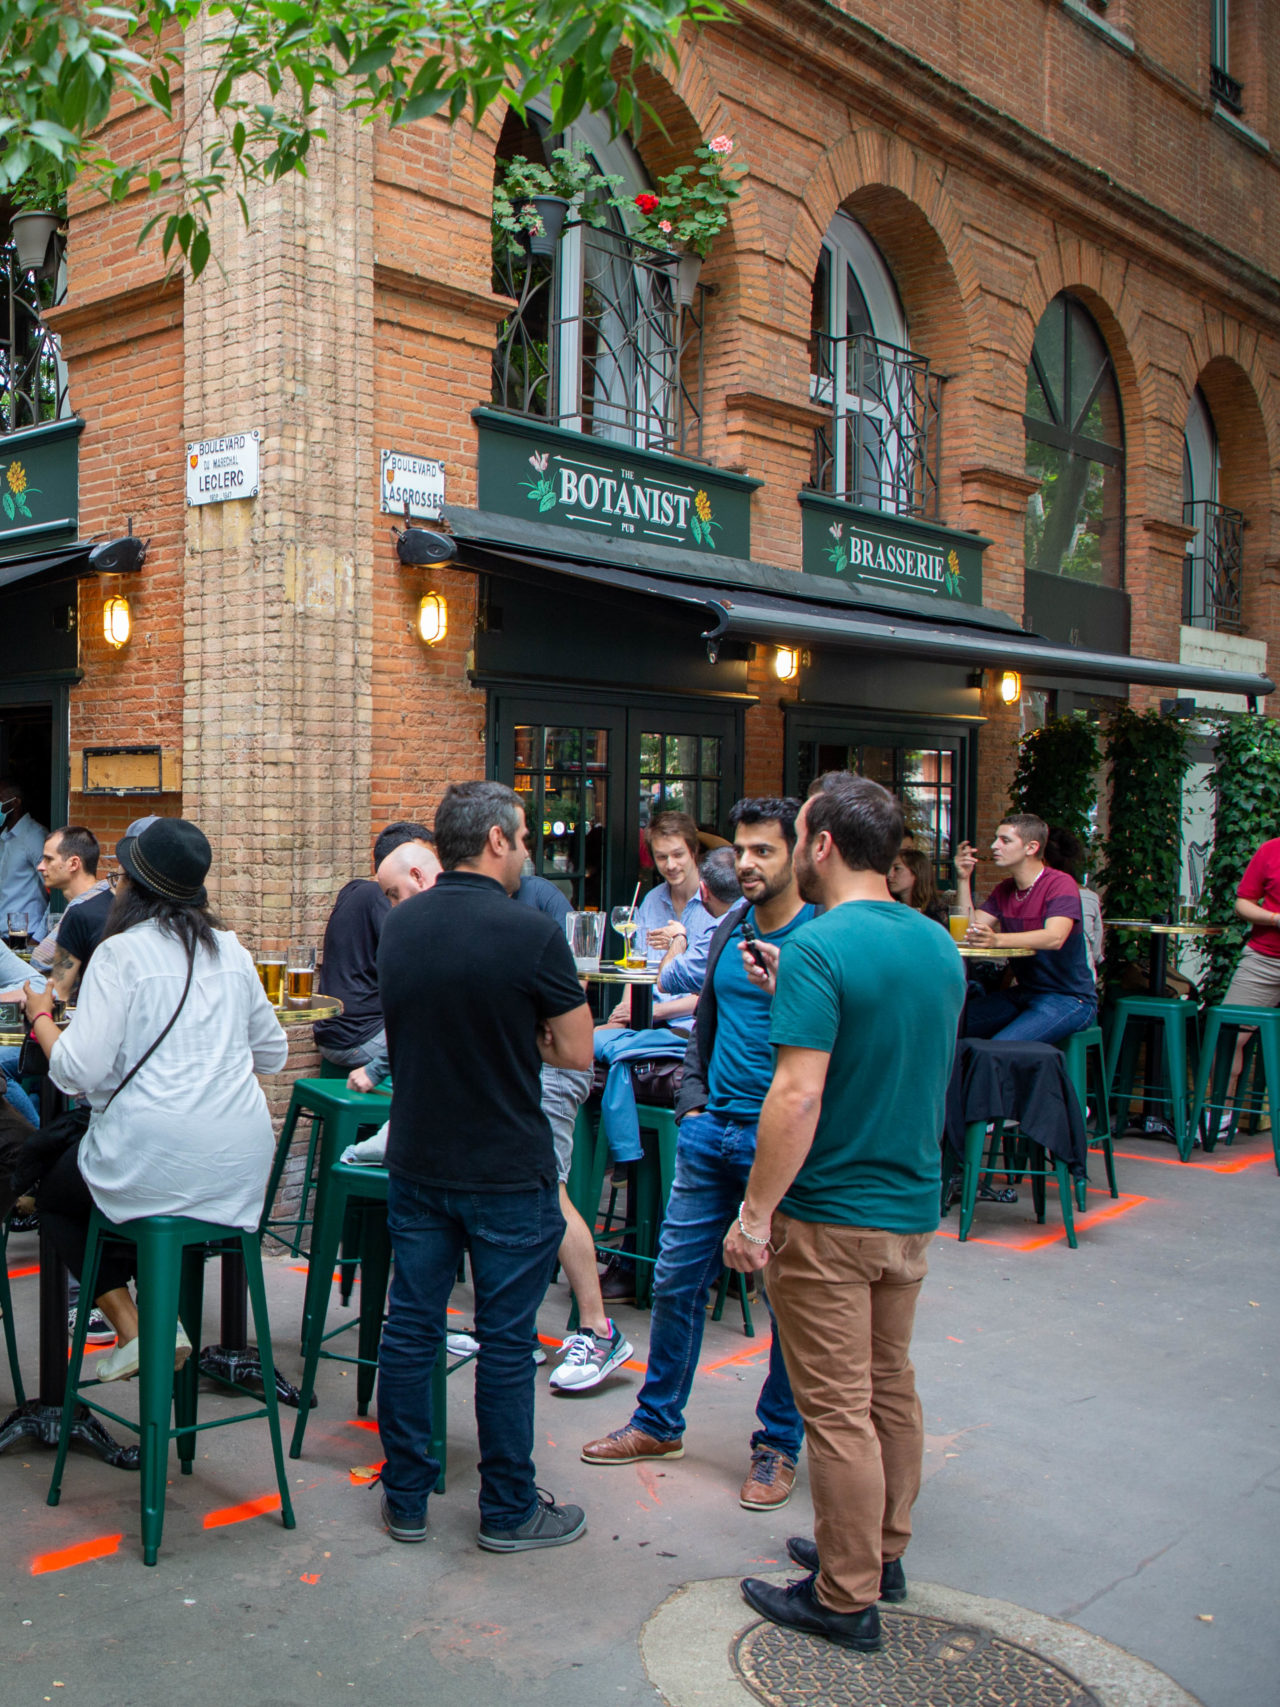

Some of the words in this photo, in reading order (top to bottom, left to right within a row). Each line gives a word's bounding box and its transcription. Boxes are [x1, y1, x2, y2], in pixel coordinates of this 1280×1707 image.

[199, 435, 245, 456] BOULEVARD
[391, 456, 437, 477] BOULEVARD
[621, 468, 635, 480] THE
[199, 469, 244, 492] LECLERC
[383, 484, 444, 509] LASCROSSES
[558, 467, 691, 530] BOTANIST
[621, 522, 635, 534] PUB
[849, 536, 945, 582] BRASSERIE
